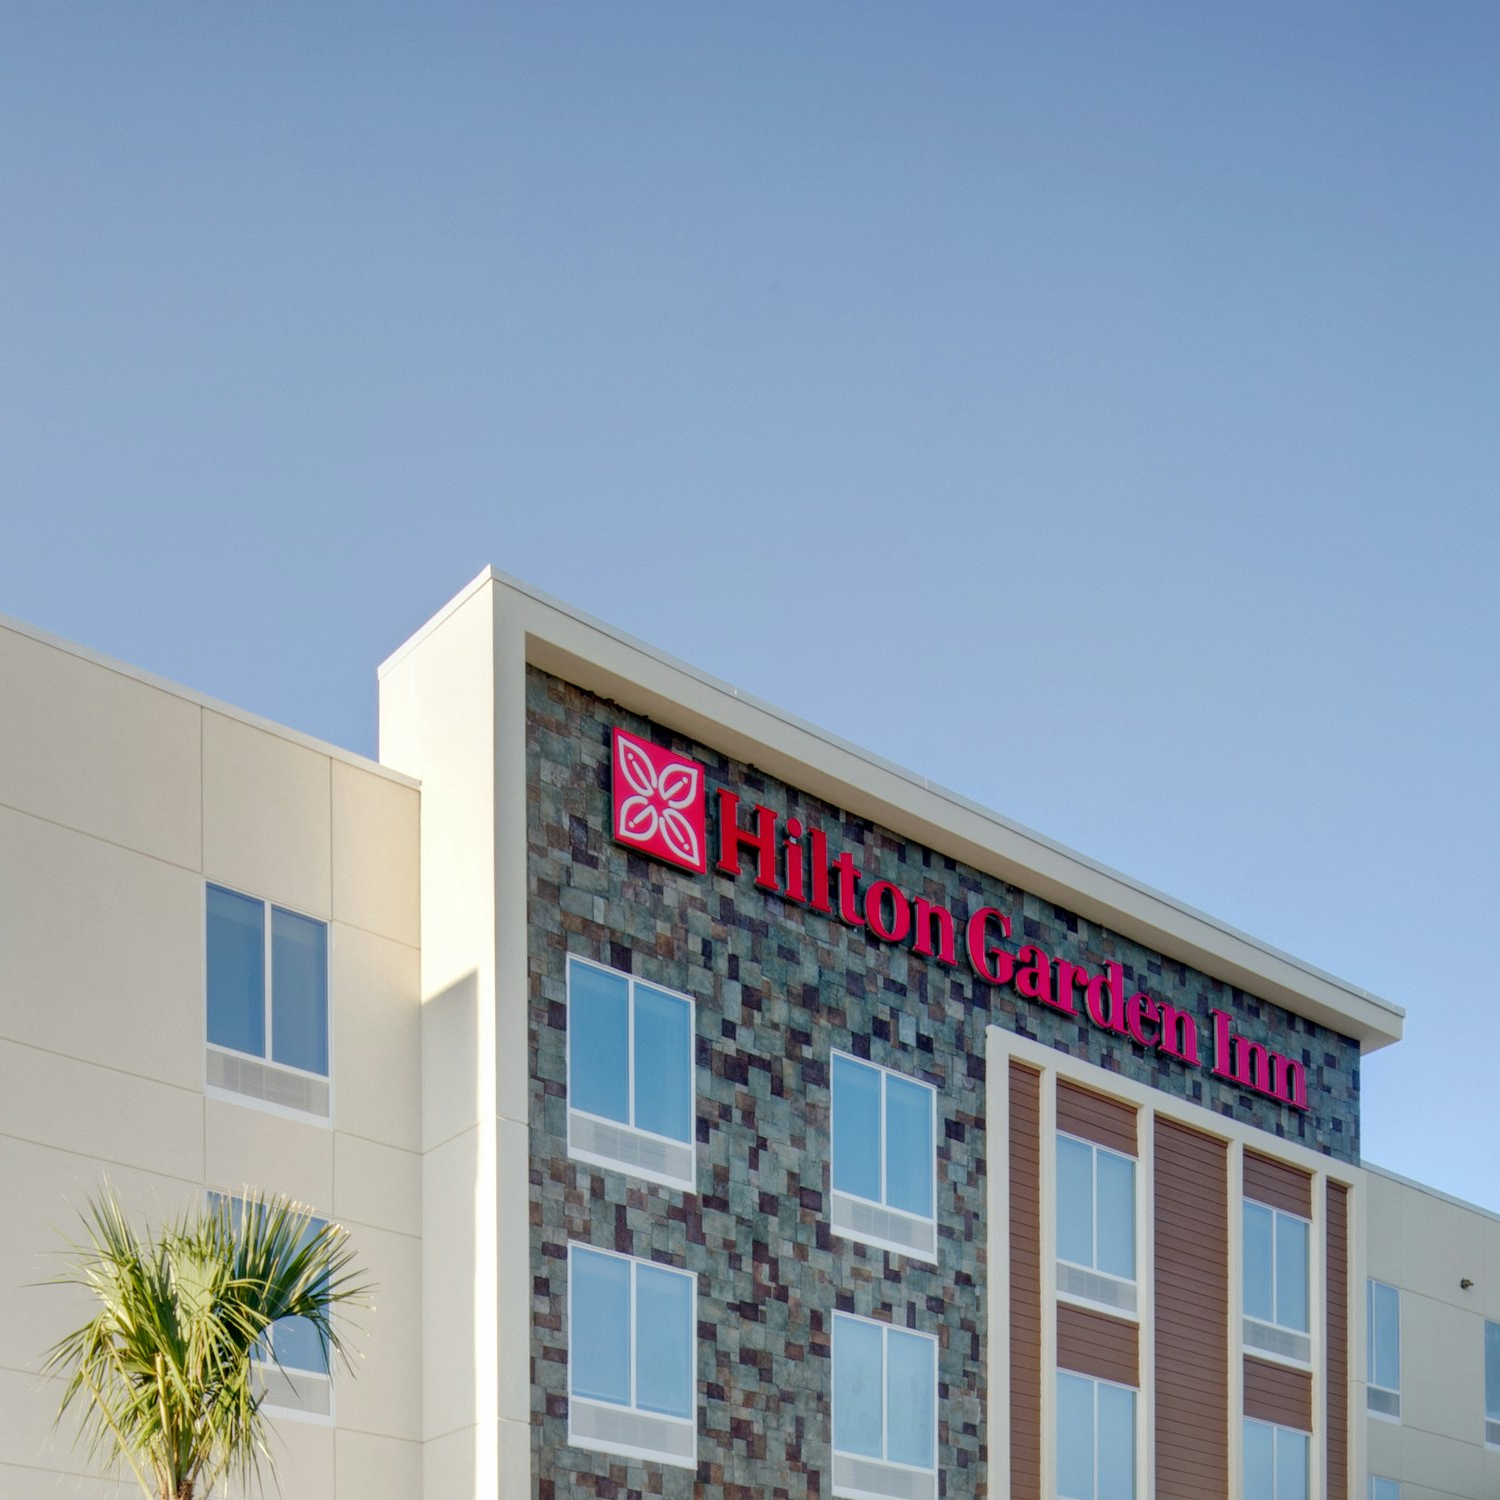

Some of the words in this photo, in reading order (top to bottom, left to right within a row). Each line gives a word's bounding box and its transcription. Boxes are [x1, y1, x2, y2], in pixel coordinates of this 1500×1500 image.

[717, 788, 957, 966] Hilton
[967, 907, 1201, 1066] Garden
[1211, 1008, 1309, 1110] Inn
